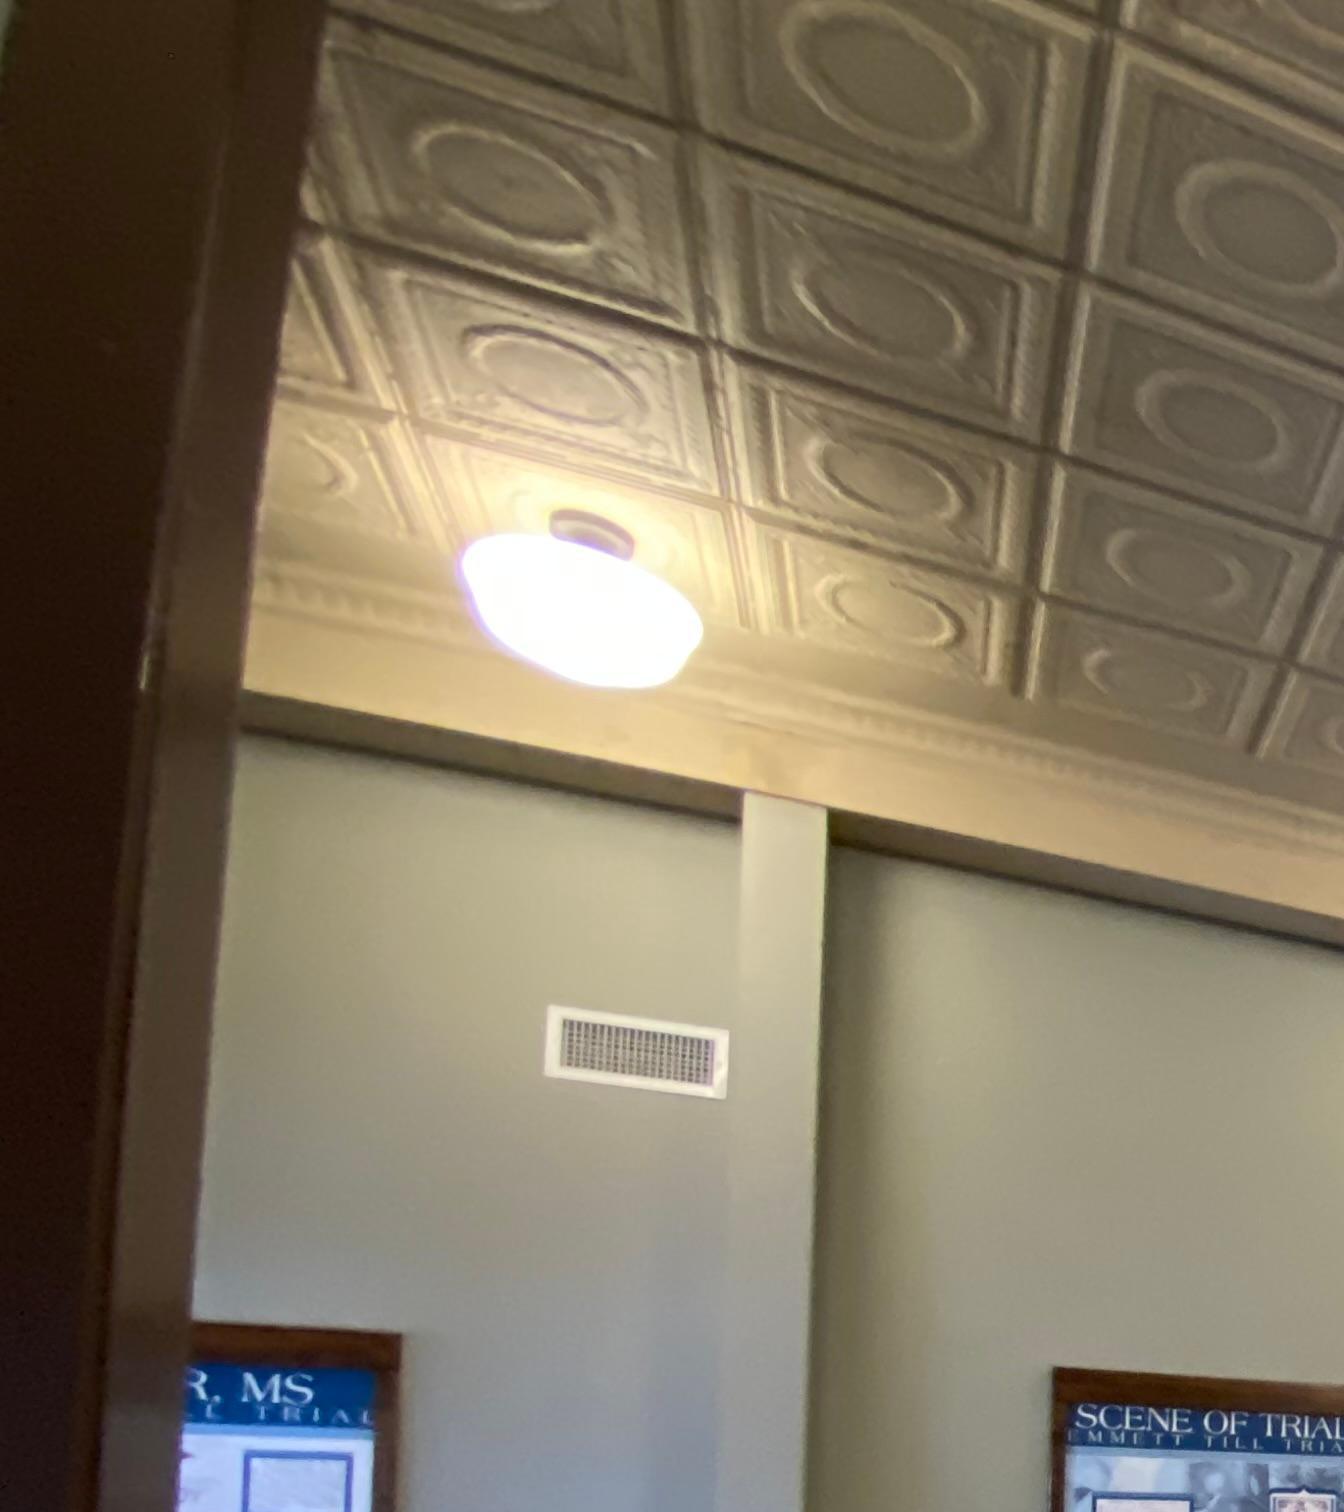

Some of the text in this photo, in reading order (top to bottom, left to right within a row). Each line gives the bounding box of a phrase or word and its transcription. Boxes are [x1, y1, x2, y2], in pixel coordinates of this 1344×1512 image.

[241, 1371, 316, 1406] MS
[1074, 1402, 1193, 1434] SCENE
[1203, 1409, 1251, 1436] OF
[1067, 1428, 1185, 1447] EMMETT
[1204, 1433, 1265, 1451] TILL
